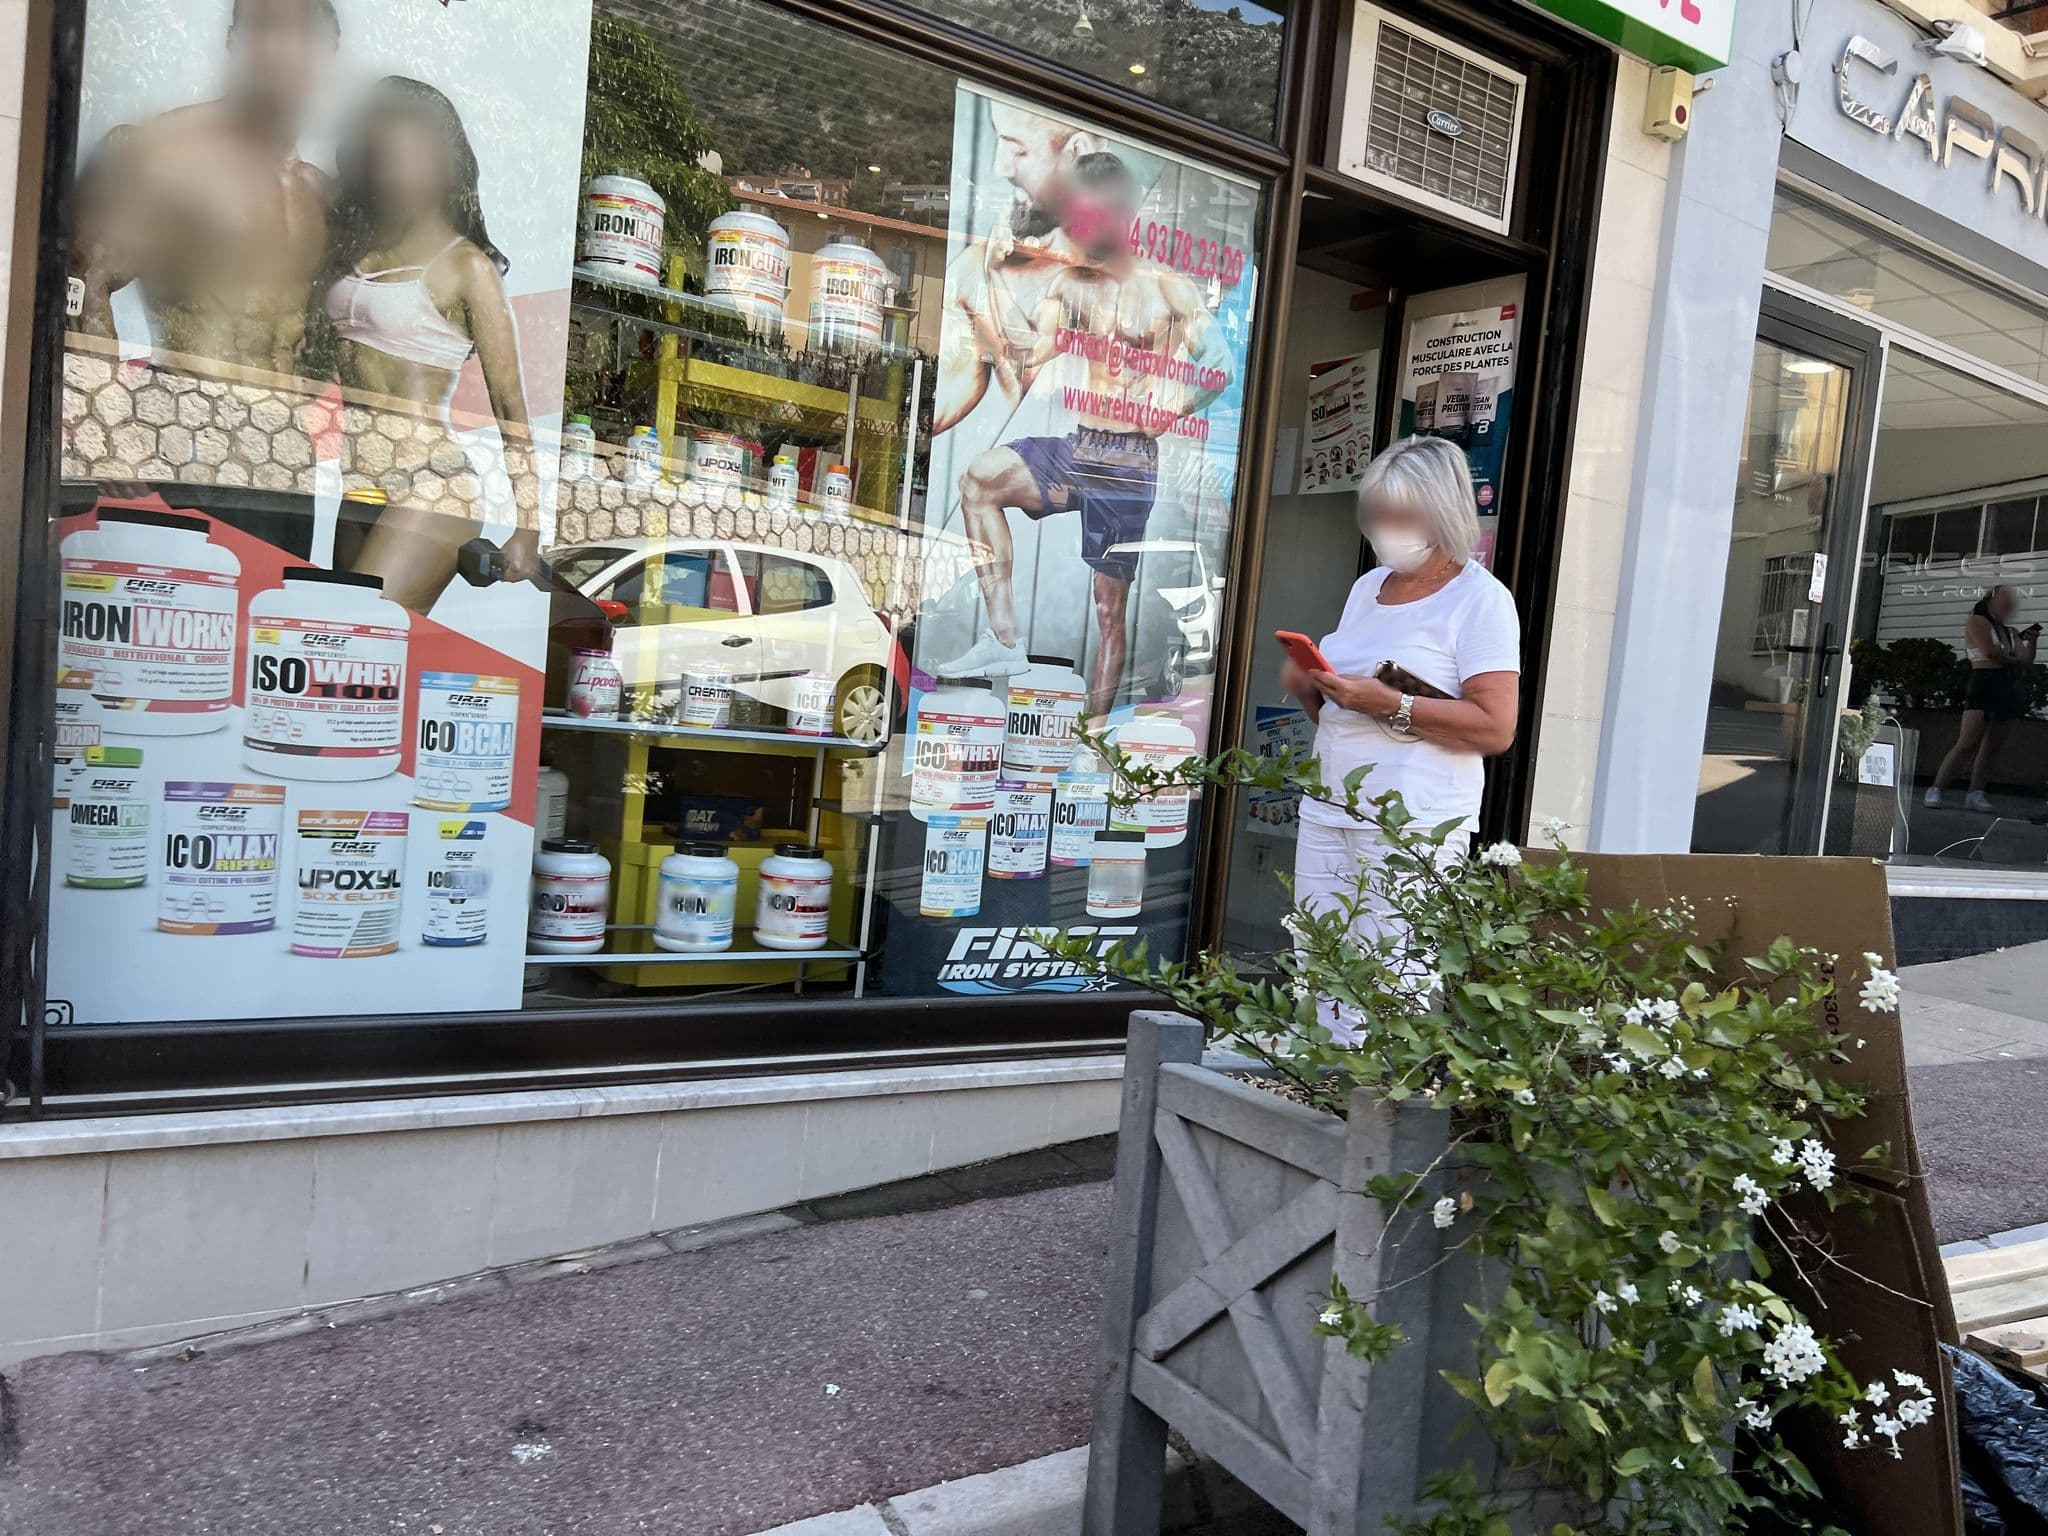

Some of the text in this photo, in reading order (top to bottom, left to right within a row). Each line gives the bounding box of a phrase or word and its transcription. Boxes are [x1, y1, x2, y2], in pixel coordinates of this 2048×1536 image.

[1431, 113, 1459, 133] Carrier
[594, 213, 635, 236] IRON
[715, 248, 752, 268] IRON
[1128, 217, 1243, 285] 4.93.78.23.20
[827, 278, 859, 297] IRON
[1427, 330, 1501, 348] CONSTRUCTION
[1412, 341, 1513, 364] MUSCULAIRE AVEC LA
[1413, 357, 1509, 376] FORCE DES PLANTES
[1063, 386, 1209, 441] www.relaxform.com
[772, 478, 786, 488] VIT
[827, 486, 841, 496] CLA
[127, 579, 181, 591] FIRST
[1901, 584, 1936, 596] BY
[63, 600, 131, 643] IRON
[134, 605, 234, 651] WORKS
[303, 633, 352, 643] FIRST
[113, 649, 187, 663] NUTRITIONAL
[252, 655, 307, 694] ISO
[312, 659, 401, 686] WHEY
[312, 684, 400, 700] 100
[448, 694, 494, 704] FIRST
[1008, 712, 1041, 736] IRON
[420, 719, 456, 753] ICO
[457, 721, 513, 756] BCAA
[916, 740, 945, 769] ICO
[947, 744, 1000, 761] WHEY
[71, 803, 118, 826] OMEGA
[199, 806, 253, 814] FIRST
[1055, 802, 1076, 825] ICO
[992, 813, 1016, 837] ICO
[1017, 814, 1048, 831] MAX
[166, 833, 212, 870] ICO
[215, 835, 276, 860] MAX
[215, 859, 274, 871] RIPPED
[926, 850, 947, 873] ICO
[947, 849, 982, 875] BCAA
[937, 962, 1000, 980] IRON
